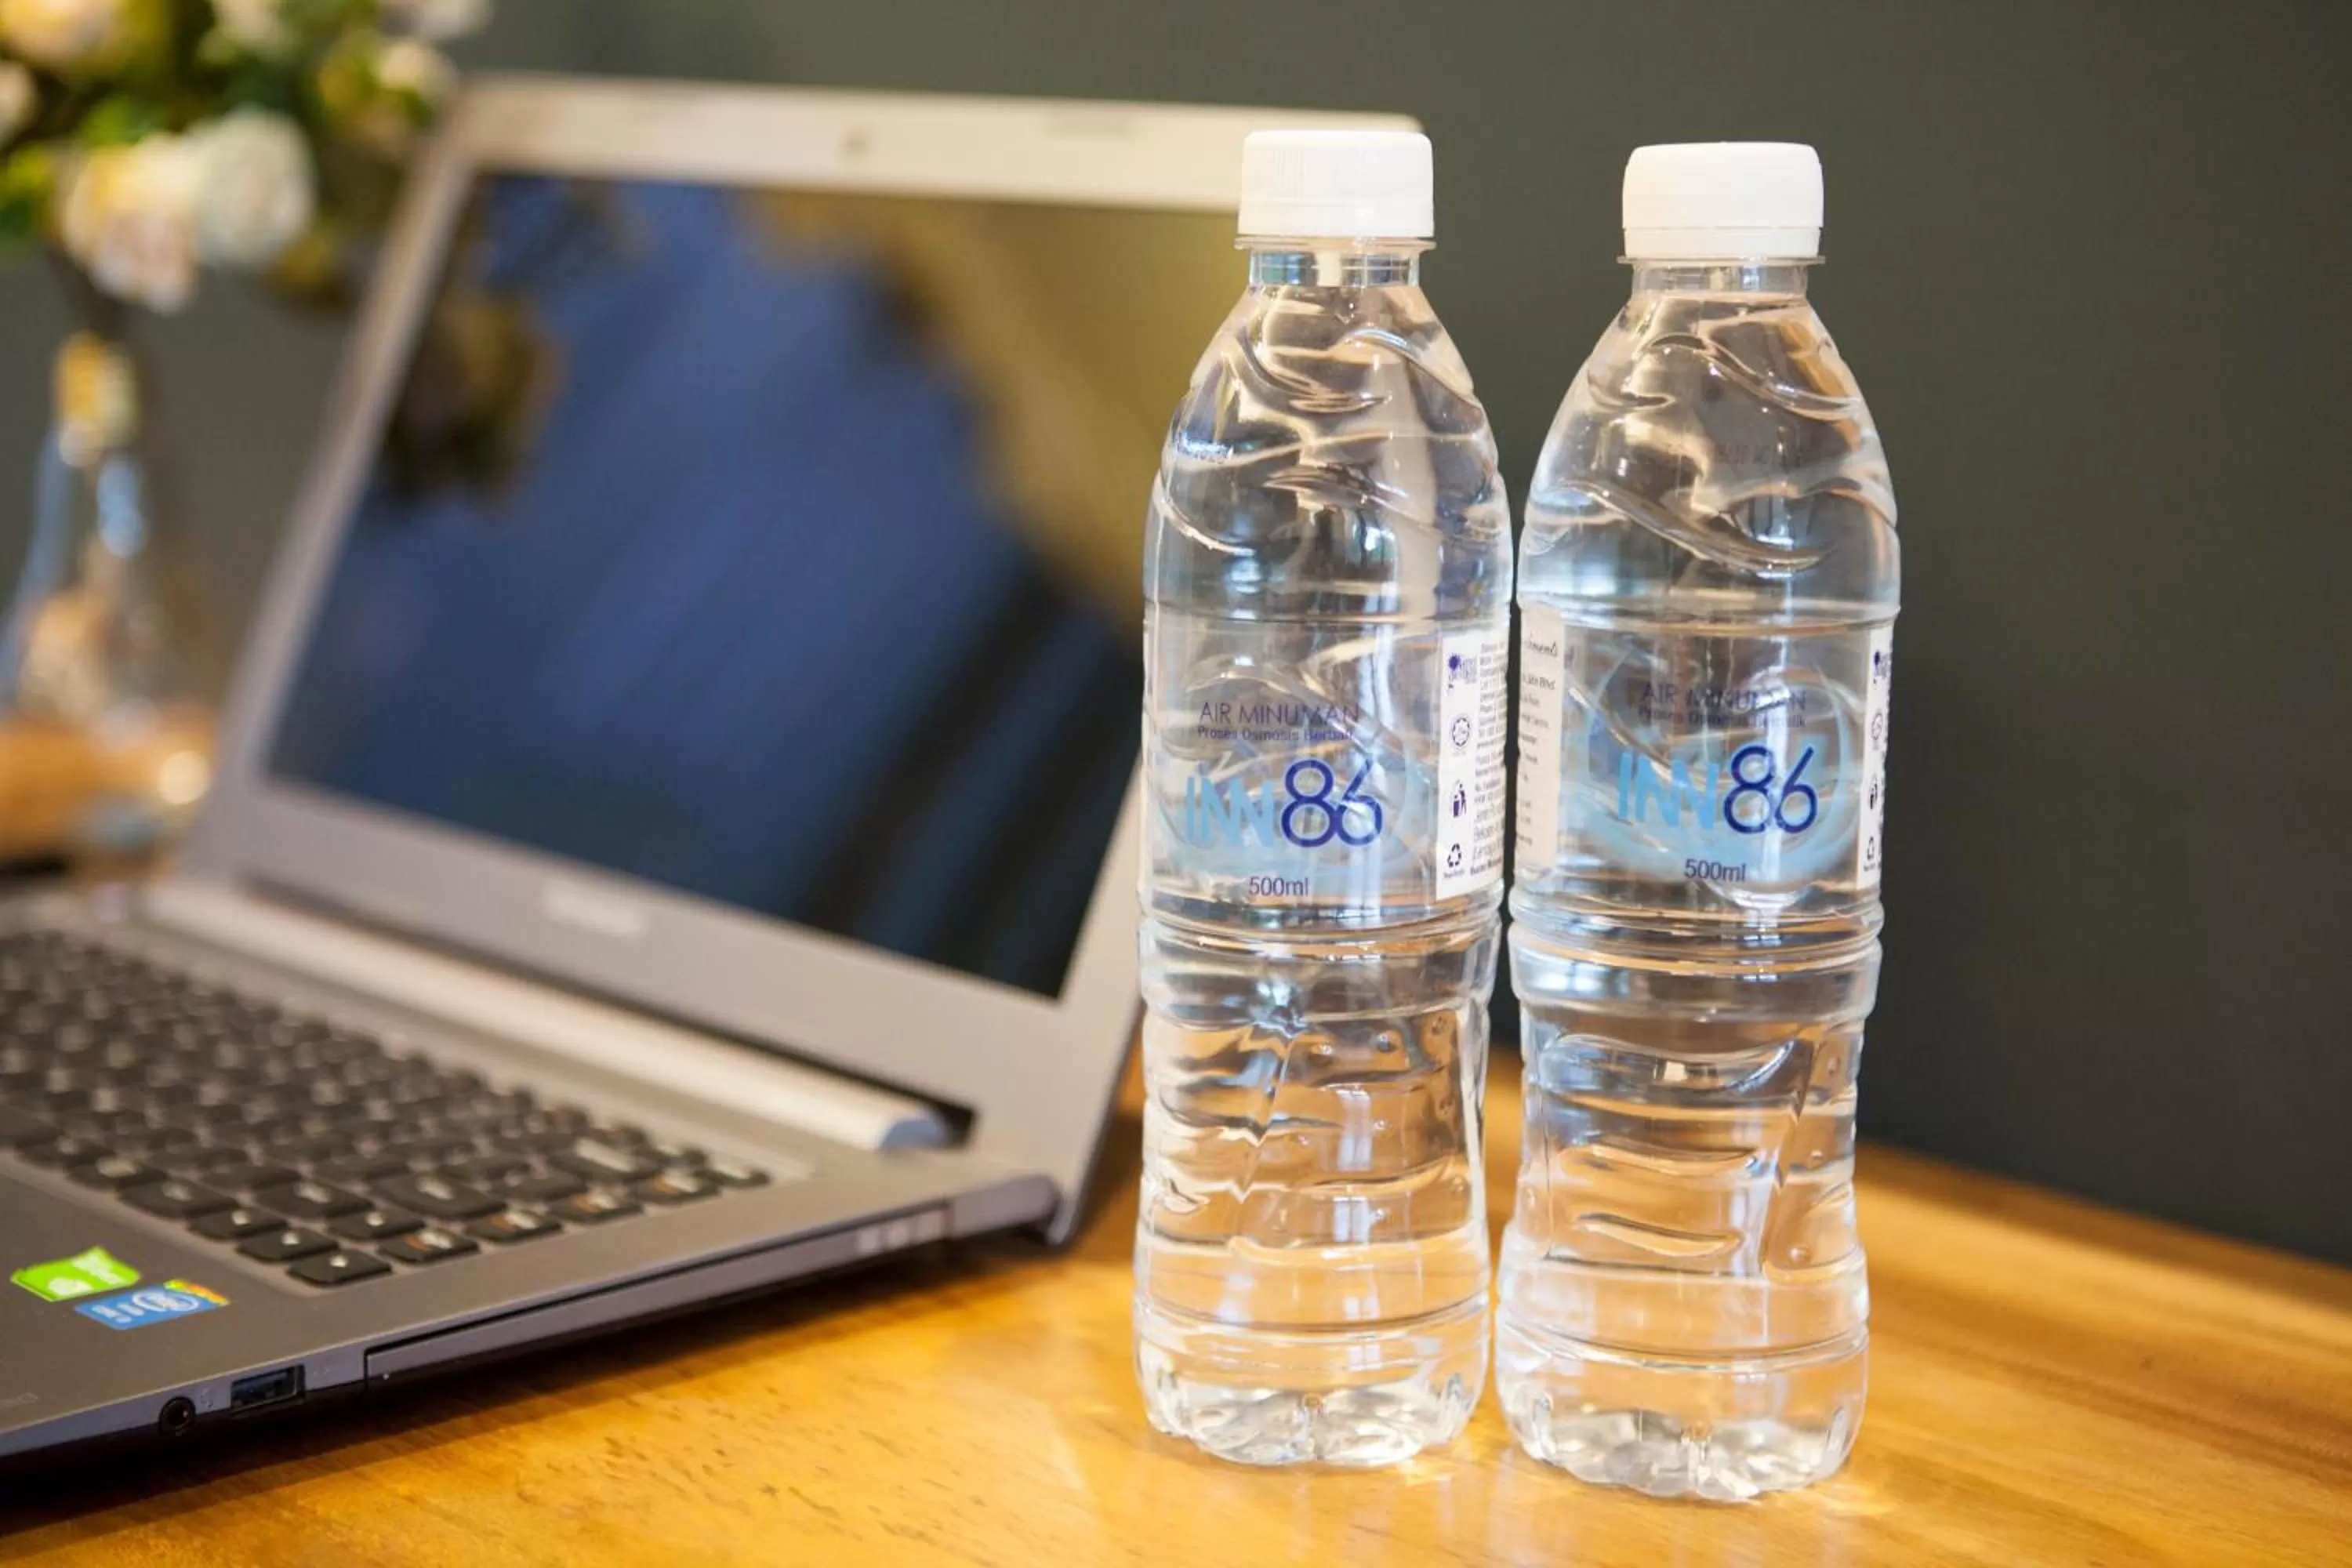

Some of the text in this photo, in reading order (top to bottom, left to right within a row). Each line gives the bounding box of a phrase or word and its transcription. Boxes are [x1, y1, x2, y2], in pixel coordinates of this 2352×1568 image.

[1199, 702, 1231, 724] AIR
[1684, 859, 1746, 883] 500ml
[1248, 876, 1309, 898] 500ml
